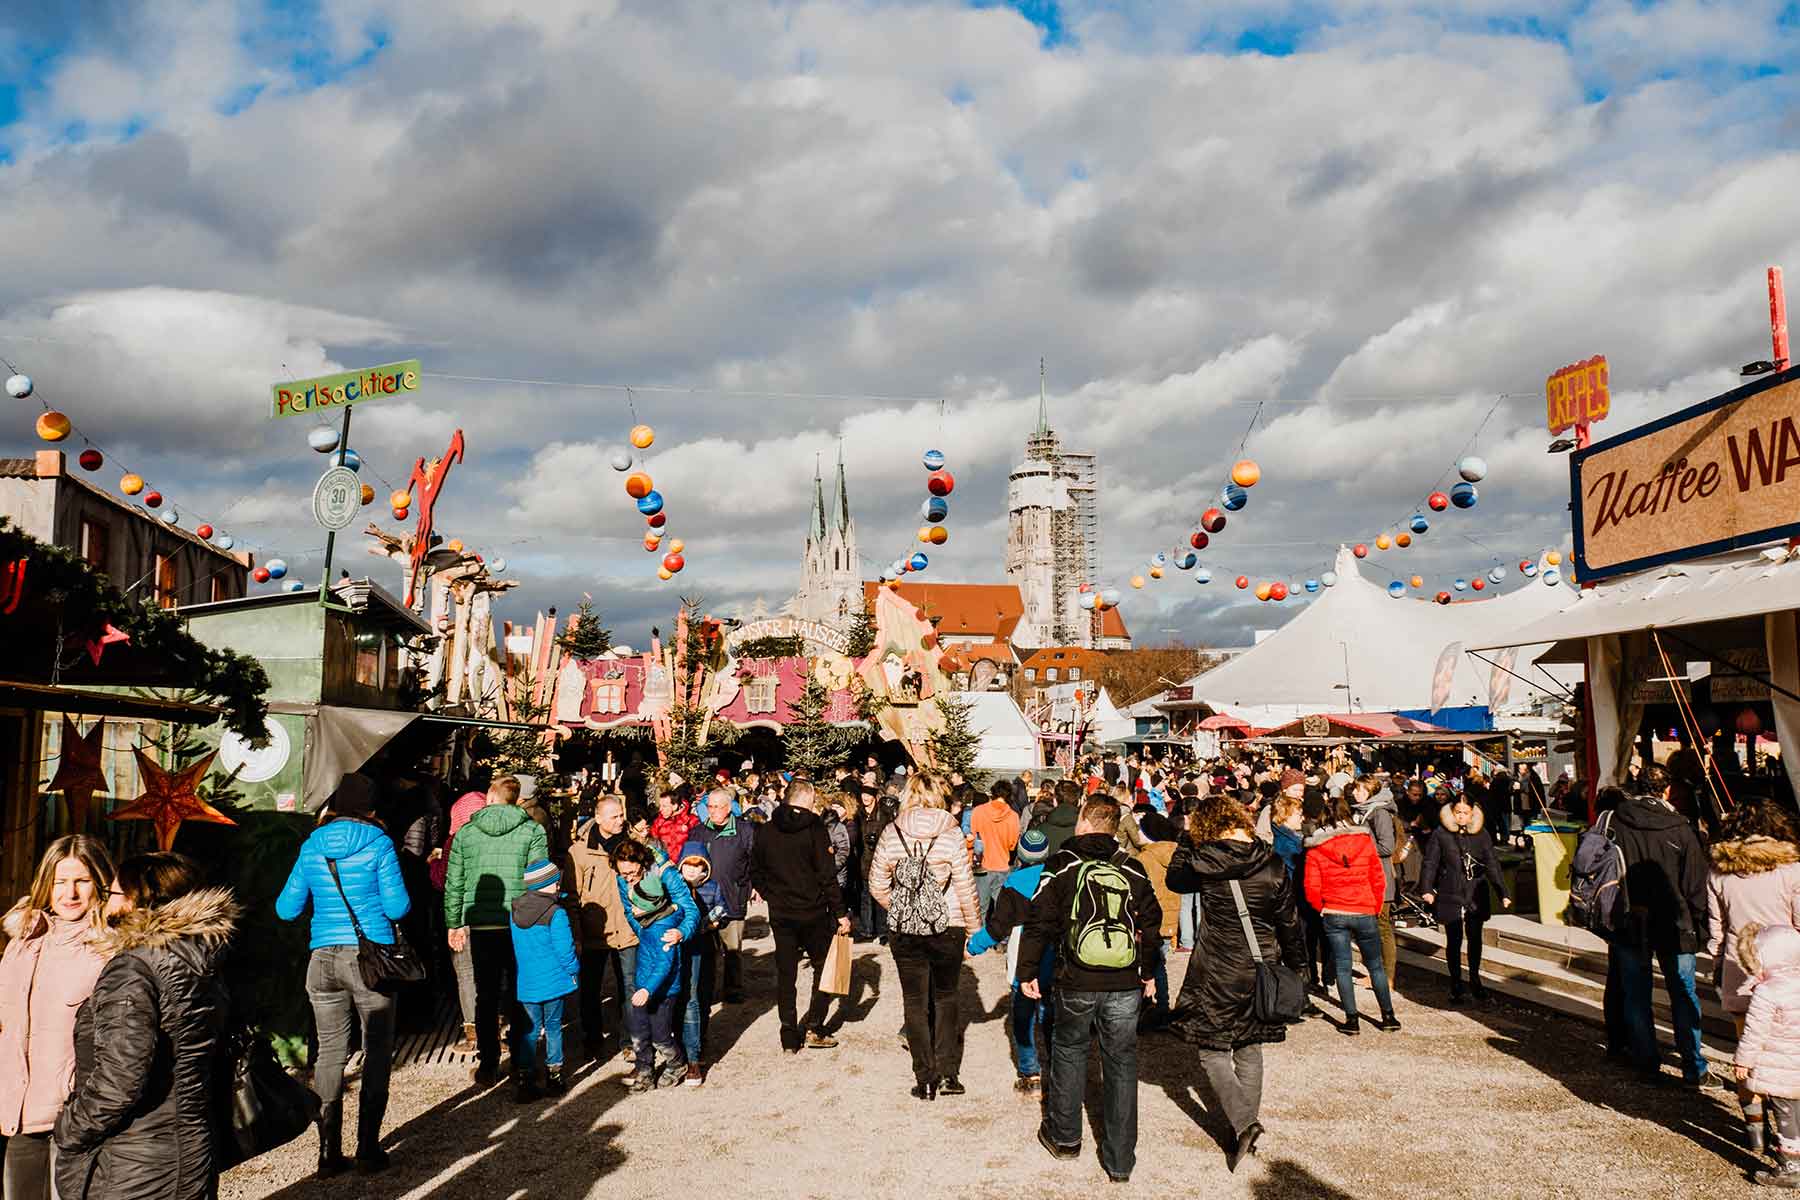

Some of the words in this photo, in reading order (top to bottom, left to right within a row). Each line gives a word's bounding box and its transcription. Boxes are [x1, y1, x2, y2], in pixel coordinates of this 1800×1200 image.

[278, 371, 417, 414] Perlsacktiere
[331, 488, 346, 504] 30
[1588, 457, 1720, 537] Kaffee
